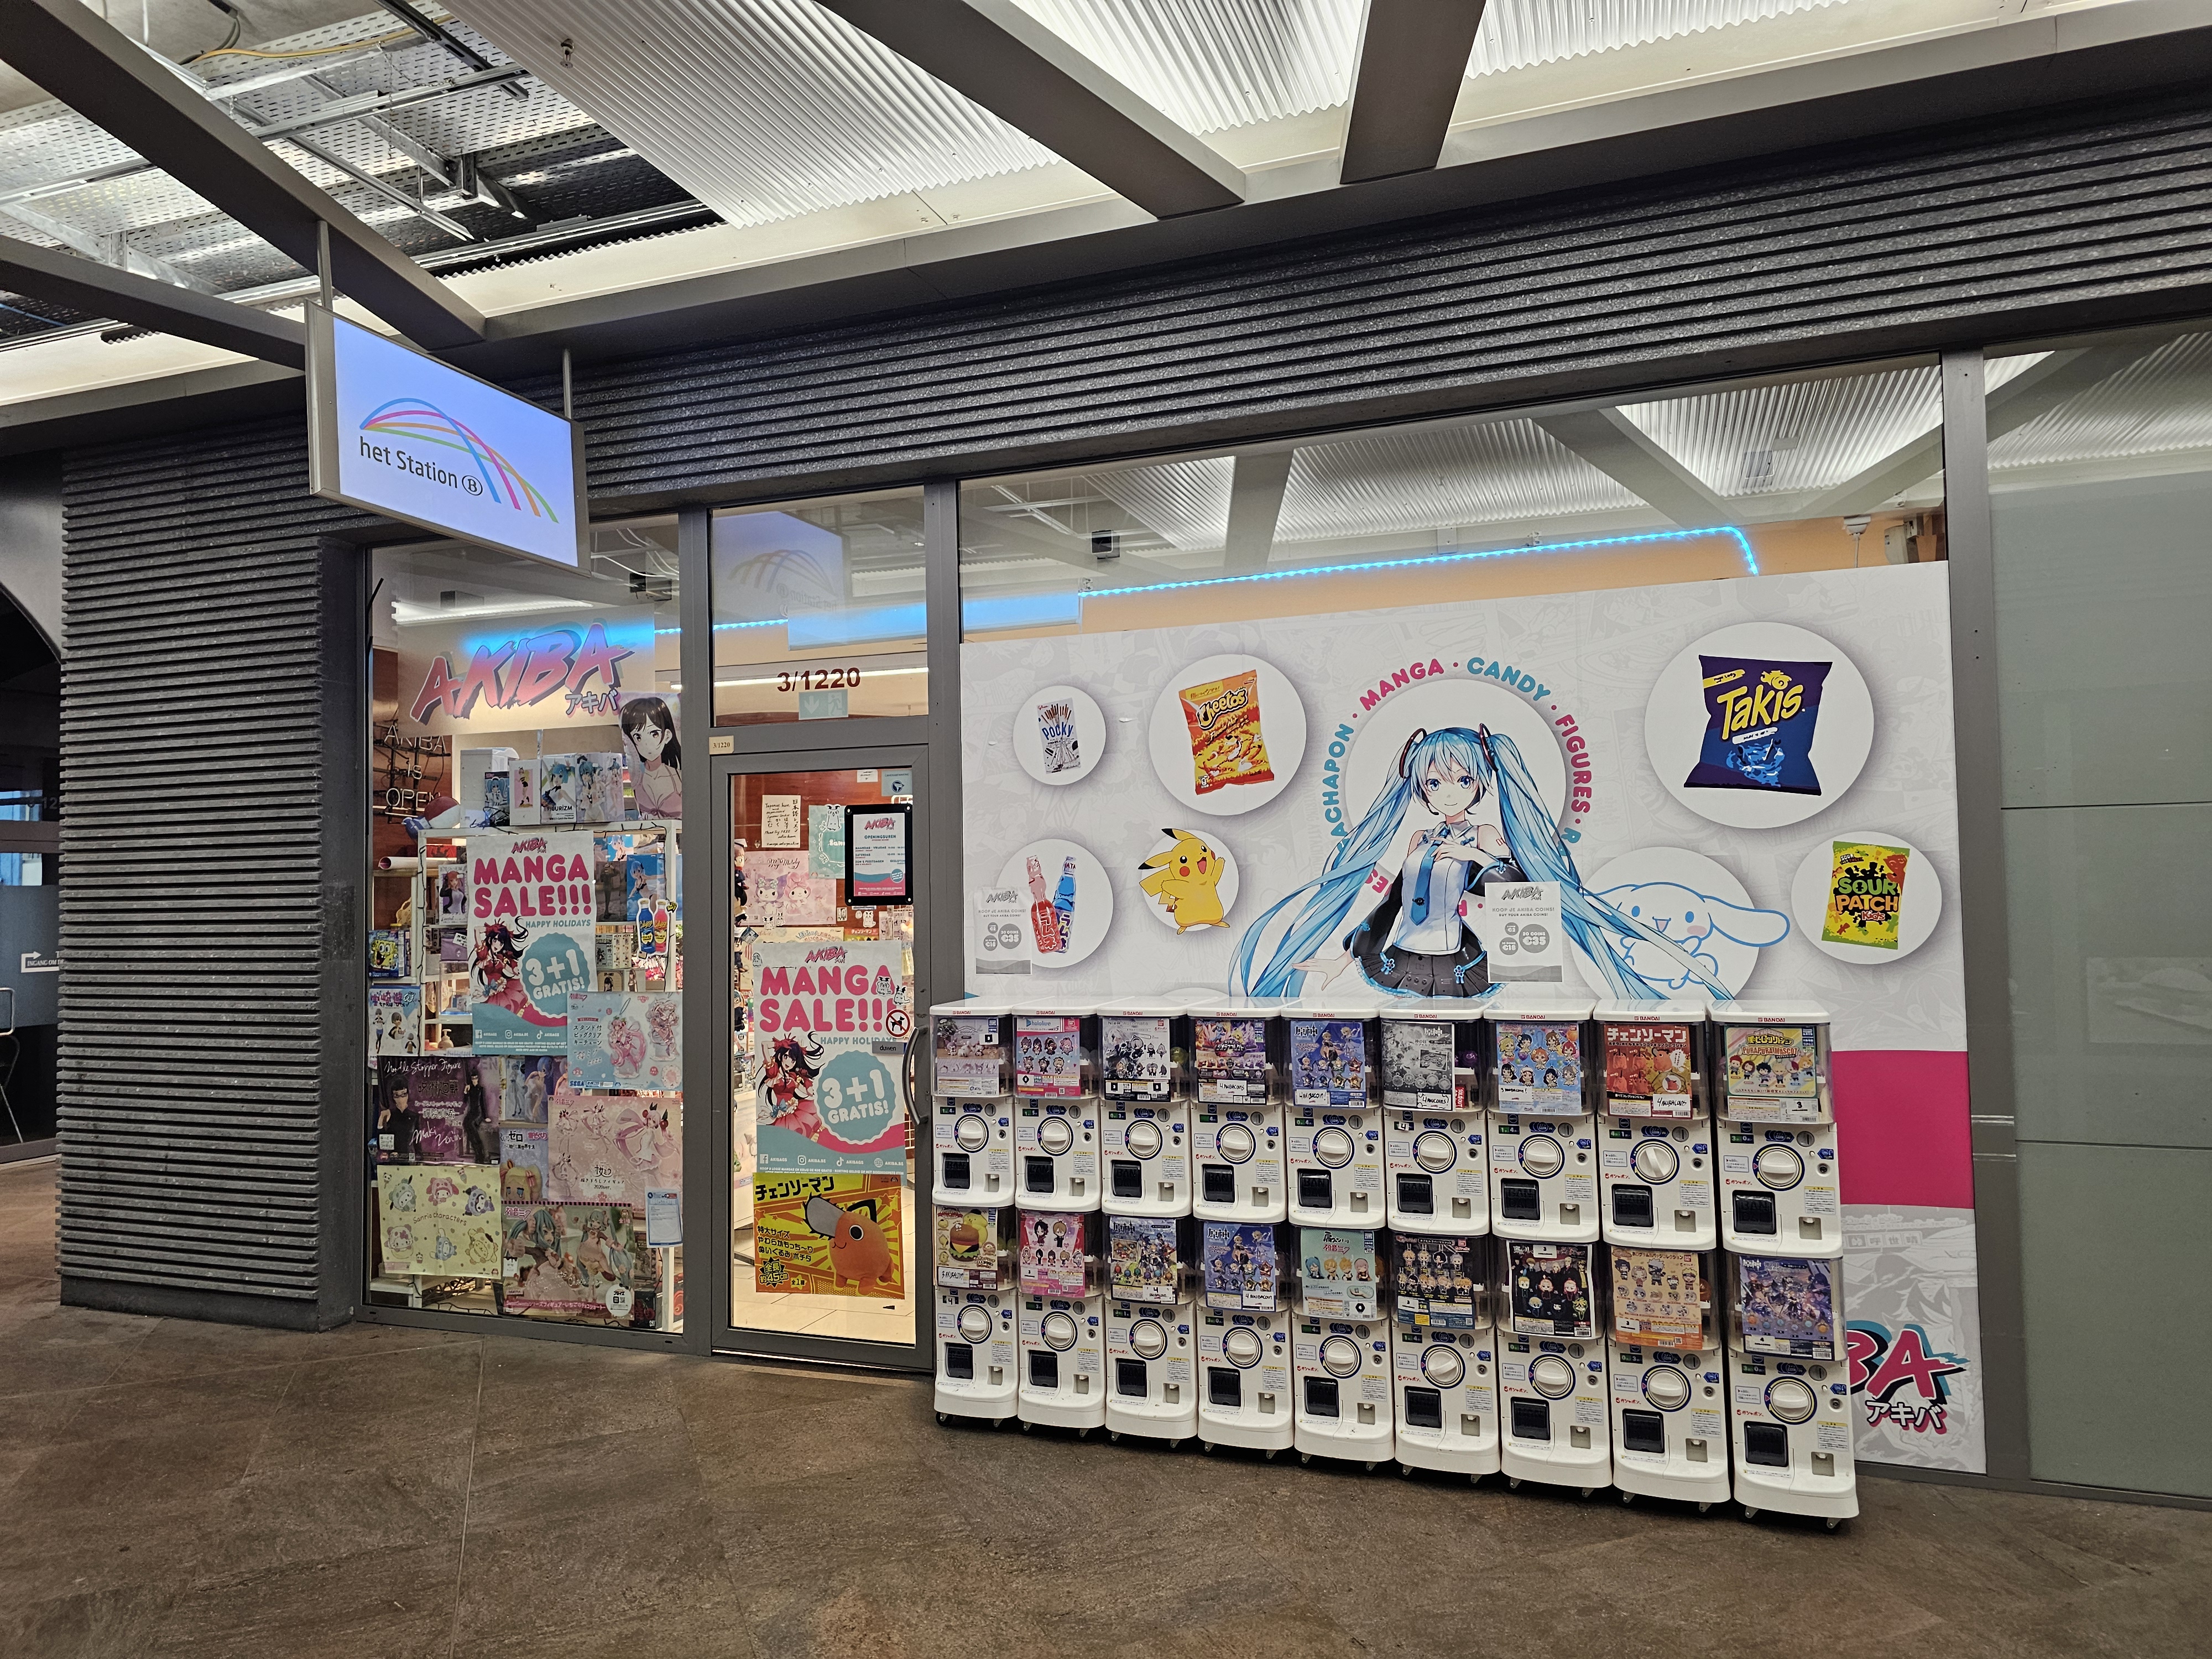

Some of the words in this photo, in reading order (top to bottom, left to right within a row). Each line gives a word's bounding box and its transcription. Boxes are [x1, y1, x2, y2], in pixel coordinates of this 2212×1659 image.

[359, 437, 391, 466] het
[397, 450, 457, 488] Station
[410, 619, 634, 723] AKIBA
[777, 667, 861, 692] 3/1220
[565, 690, 619, 716] アキバ
[1198, 690, 1248, 728] Cheetos
[1717, 685, 1803, 740] Takis
[1359, 659, 1444, 711] MANGA
[1467, 657, 1551, 701] CANDY
[1556, 714, 1592, 813] FIGURES
[1322, 724, 1354, 850] ACHAPON
[864, 817, 896, 830] AKIBA
[511, 837, 547, 854] AKIBA
[474, 854, 589, 885] MANGA
[986, 890, 1018, 902] AKIBA
[1501, 886, 1543, 900] AKIBA
[1839, 878, 1897, 895] SOUR
[474, 884, 591, 918] SALE!!!
[1837, 895, 1898, 911] PATCH
[553, 919, 591, 927] HOLIDAYS
[1861, 910, 1886, 920] Kids
[1040, 912, 1057, 950] ラムネ
[1522, 936, 1546, 945] €35
[805, 946, 848, 963] AKIBA
[525, 949, 580, 985] 3+1
[533, 977, 585, 999] GRATIS!
[760, 964, 895, 996] MANGA
[1607, 1028, 1687, 1042] チェンソーマン
[1743, 1046, 1772, 1055] PURAPURA
[1773, 1046, 1798, 1056] MASCOT
[822, 1069, 885, 1108] 3+1
[828, 1099, 889, 1124] GRATIS!
[755, 1176, 834, 1201] チェンソーマン
[413, 1213, 432, 1224] Sanrio
[504, 1207, 531, 1220] 初音ミク
[758, 1225, 790, 1239] 特大サイズ
[759, 1246, 790, 1258] ぬいぐるみ
[793, 1253, 811, 1262] ポチタ
[1323, 1244, 1350, 1254] 初音ミク
[765, 1262, 780, 1272] 全長
[1865, 1400, 1945, 1432] アキバ
